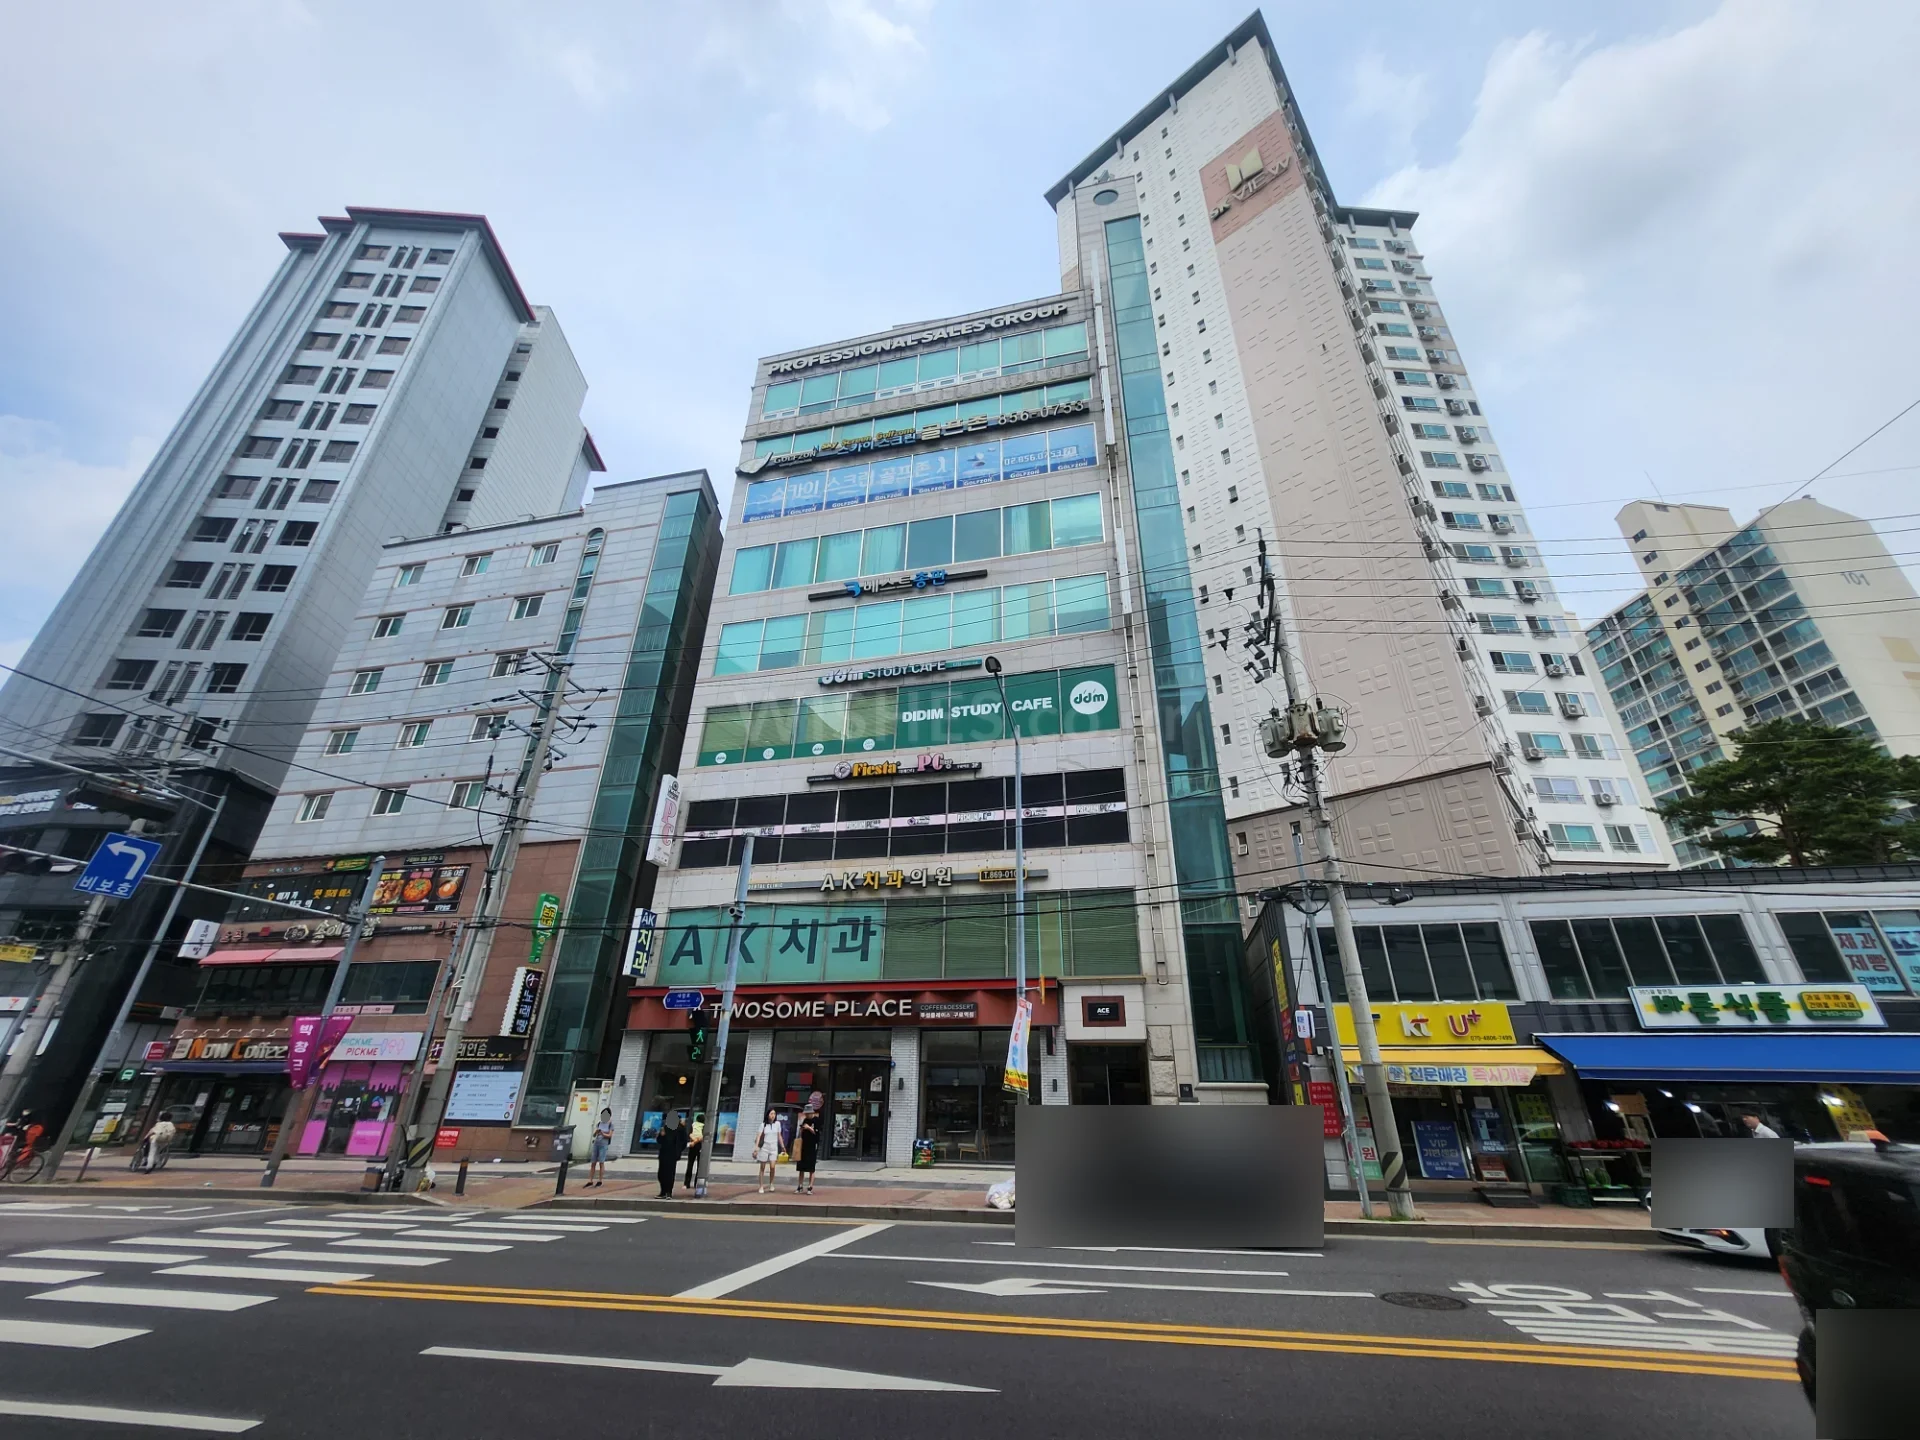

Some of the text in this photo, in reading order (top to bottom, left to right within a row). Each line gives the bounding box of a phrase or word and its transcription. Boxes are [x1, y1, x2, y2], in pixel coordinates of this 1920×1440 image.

[1231, 152, 1292, 202] VIEW
[768, 303, 1069, 375] PROFESSIONAL SALES GROUP
[998, 400, 1085, 426] 856-0753
[863, 568, 949, 594] 베스트총판
[1840, 572, 1871, 587] 101
[911, 660, 946, 674] CAFE
[901, 696, 1053, 723] DIDIM STUDY CAFE
[852, 760, 898, 777] Fiesta
[78, 876, 130, 896] 비보호
[641, 911, 655, 927] AK
[516, 990, 535, 1034] 노래방
[709, 999, 825, 1020] TWOSOME
[833, 998, 913, 1018] PLACE
[1652, 991, 1791, 1024] 바른식품
[1399, 1011, 1432, 1038] kt
[1448, 1009, 1482, 1037] U+
[1409, 1065, 1468, 1083] 전문매장
